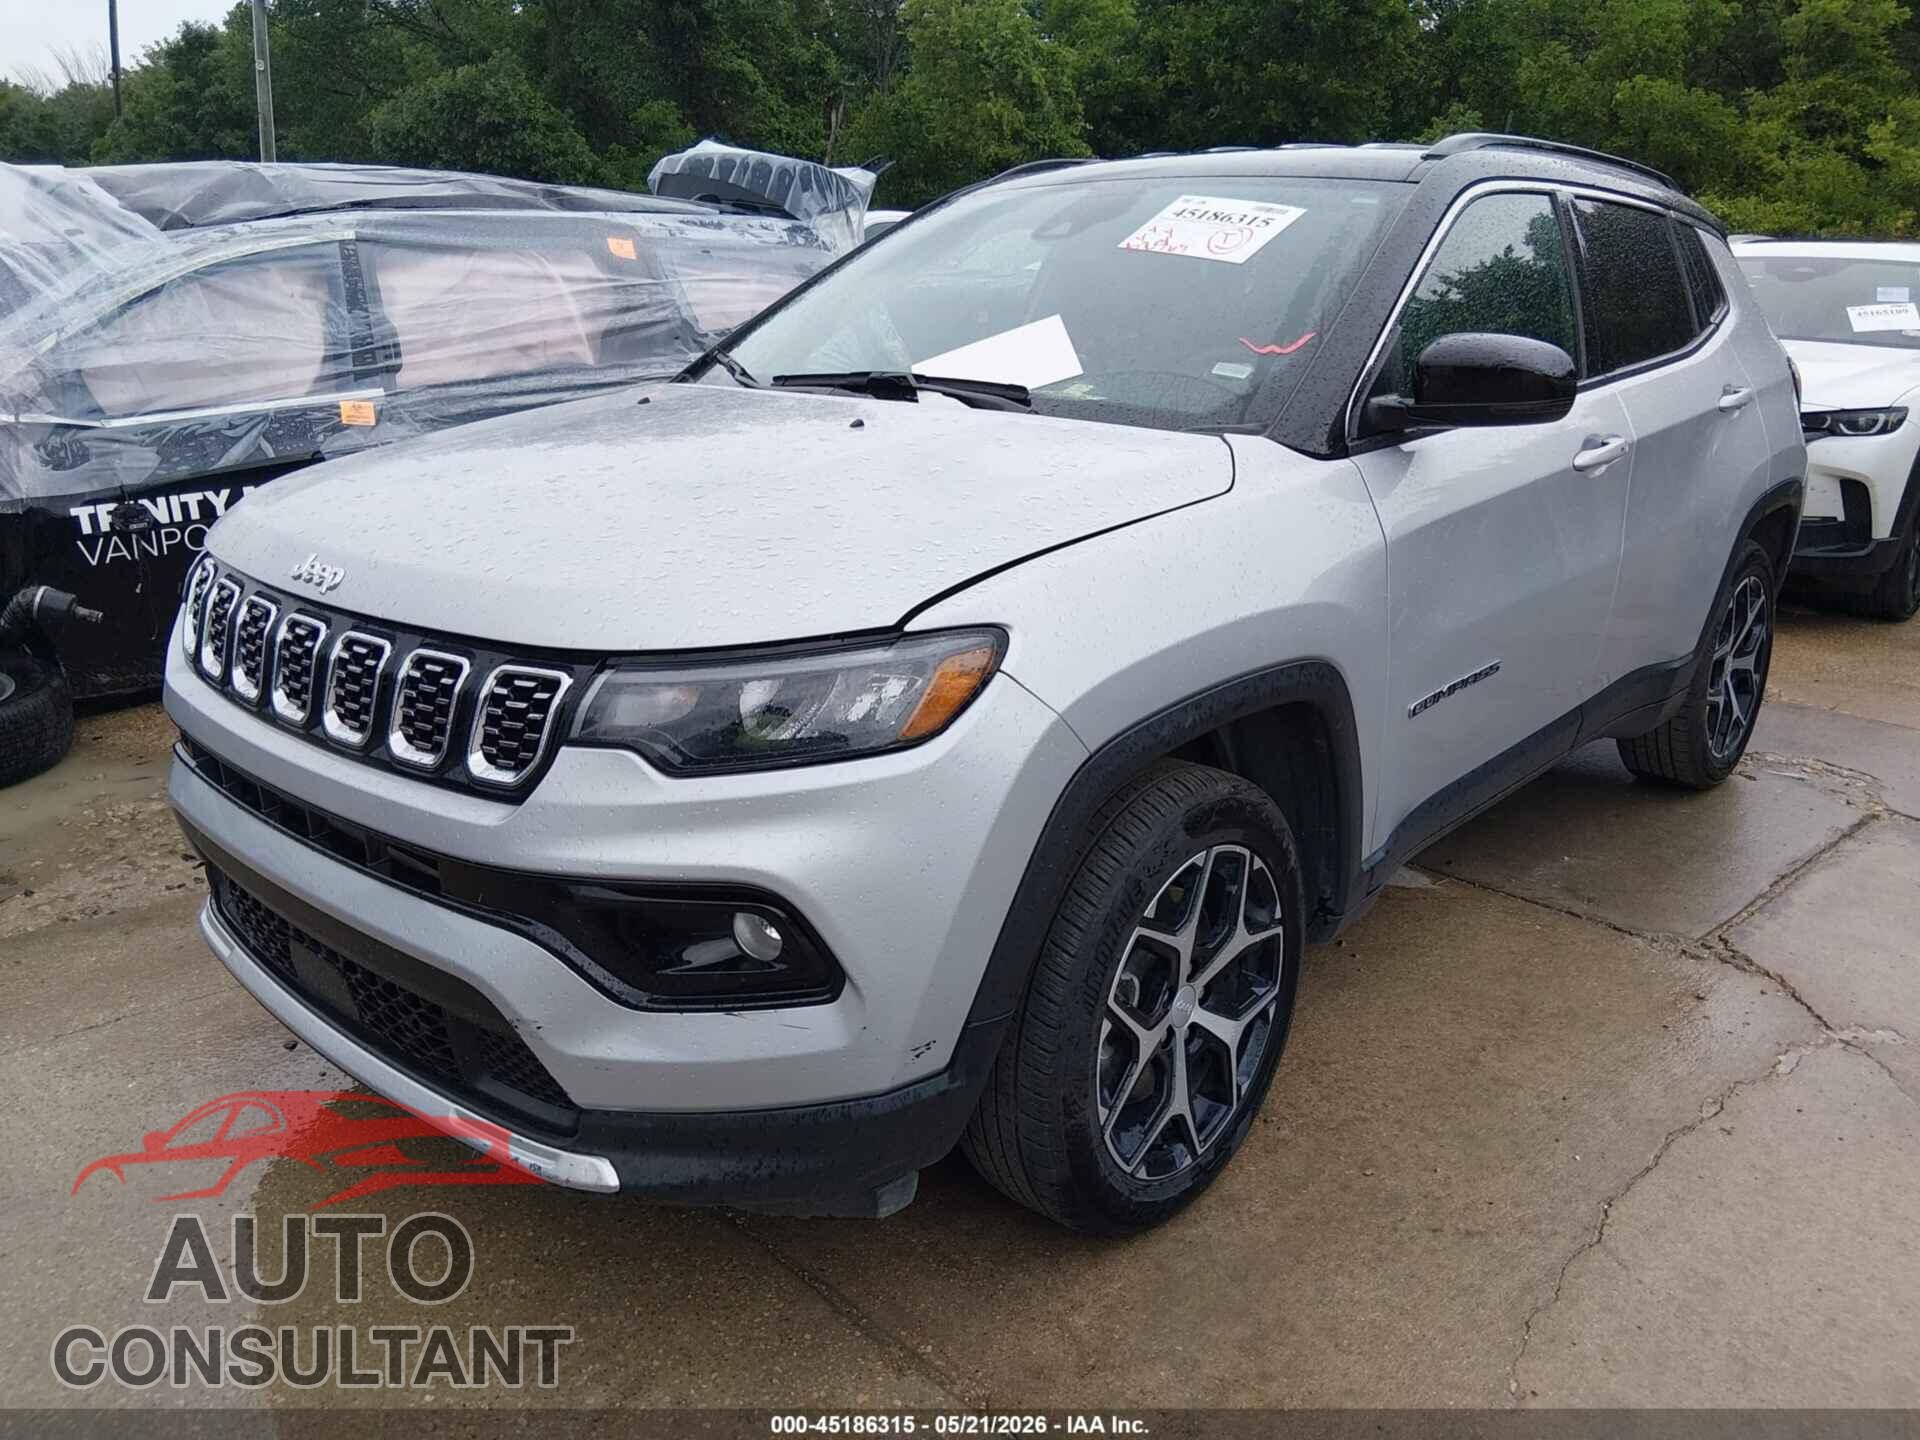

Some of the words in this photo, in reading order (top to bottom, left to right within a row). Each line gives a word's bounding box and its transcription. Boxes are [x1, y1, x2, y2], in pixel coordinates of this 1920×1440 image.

[1172, 207, 1276, 228] 45186315
[69, 488, 231, 535] TRNITY
[291, 552, 346, 597] Jeep
[1408, 659, 1503, 719] COMPASS
